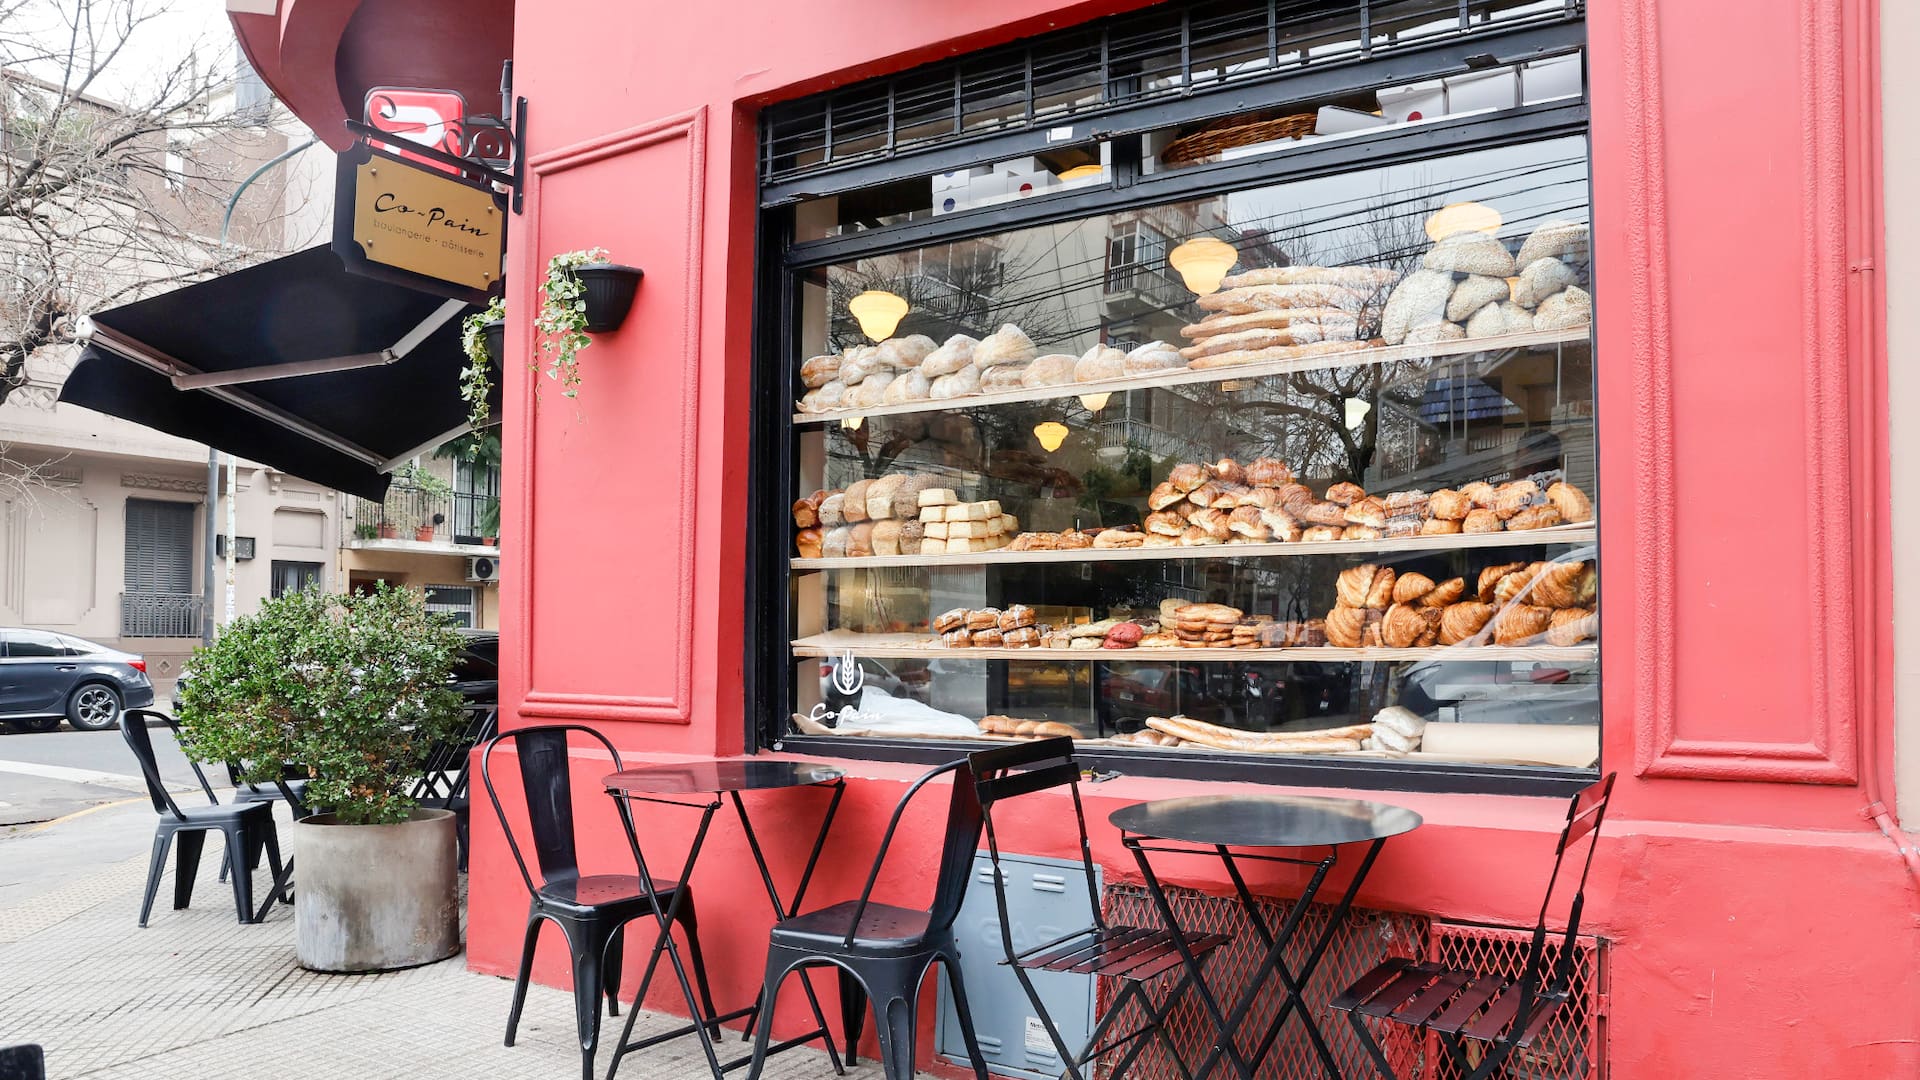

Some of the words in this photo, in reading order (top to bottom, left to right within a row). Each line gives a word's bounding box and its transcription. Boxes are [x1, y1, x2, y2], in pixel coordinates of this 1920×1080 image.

[374, 192, 489, 237] Co-Pain
[373, 218, 432, 243] boulangerie
[441, 239, 485, 258] pâtisserie
